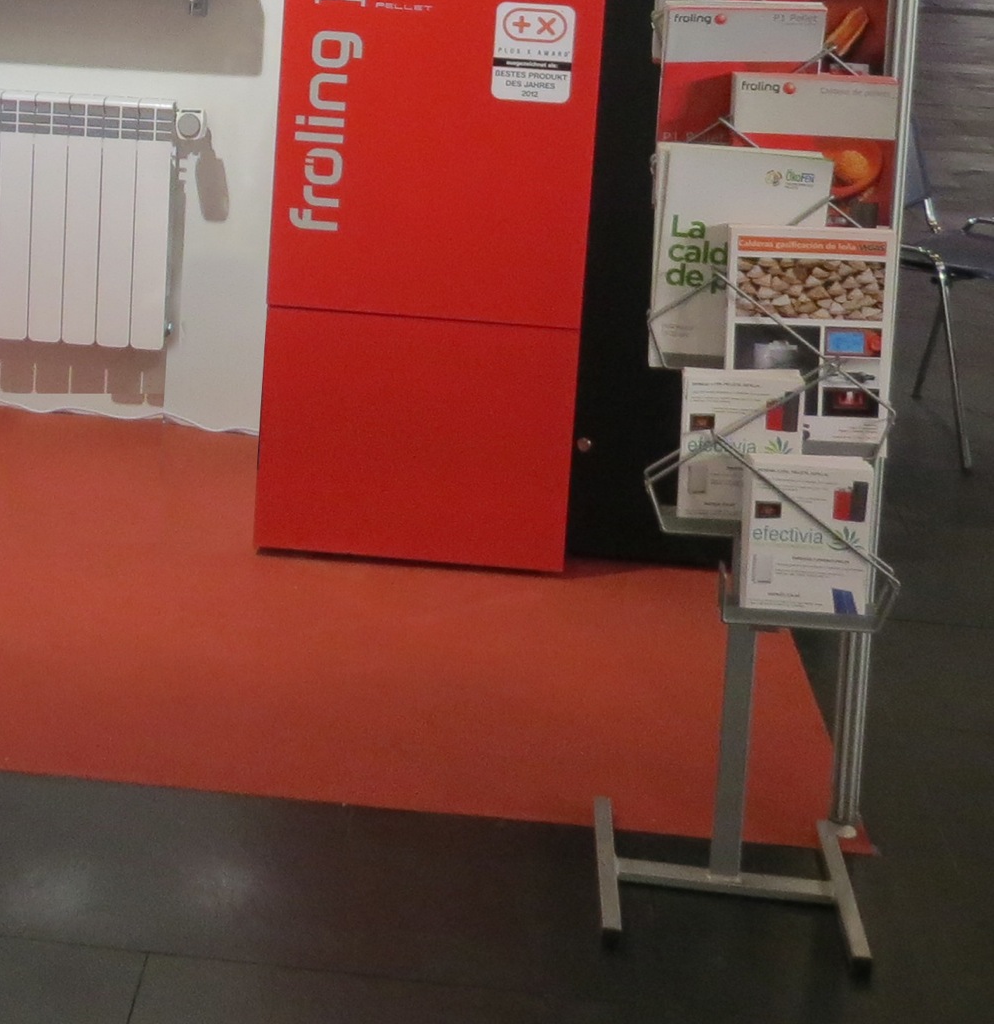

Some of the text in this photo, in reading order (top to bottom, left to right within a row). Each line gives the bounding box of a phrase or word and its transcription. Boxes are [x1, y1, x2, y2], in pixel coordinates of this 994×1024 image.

[375, 2, 434, 11] PELLET
[528, 72, 568, 80] PRODUKT
[671, 214, 706, 239] La
[738, 239, 774, 248] Calderas
[666, 263, 704, 287] de
[752, 525, 824, 545] efectivia
